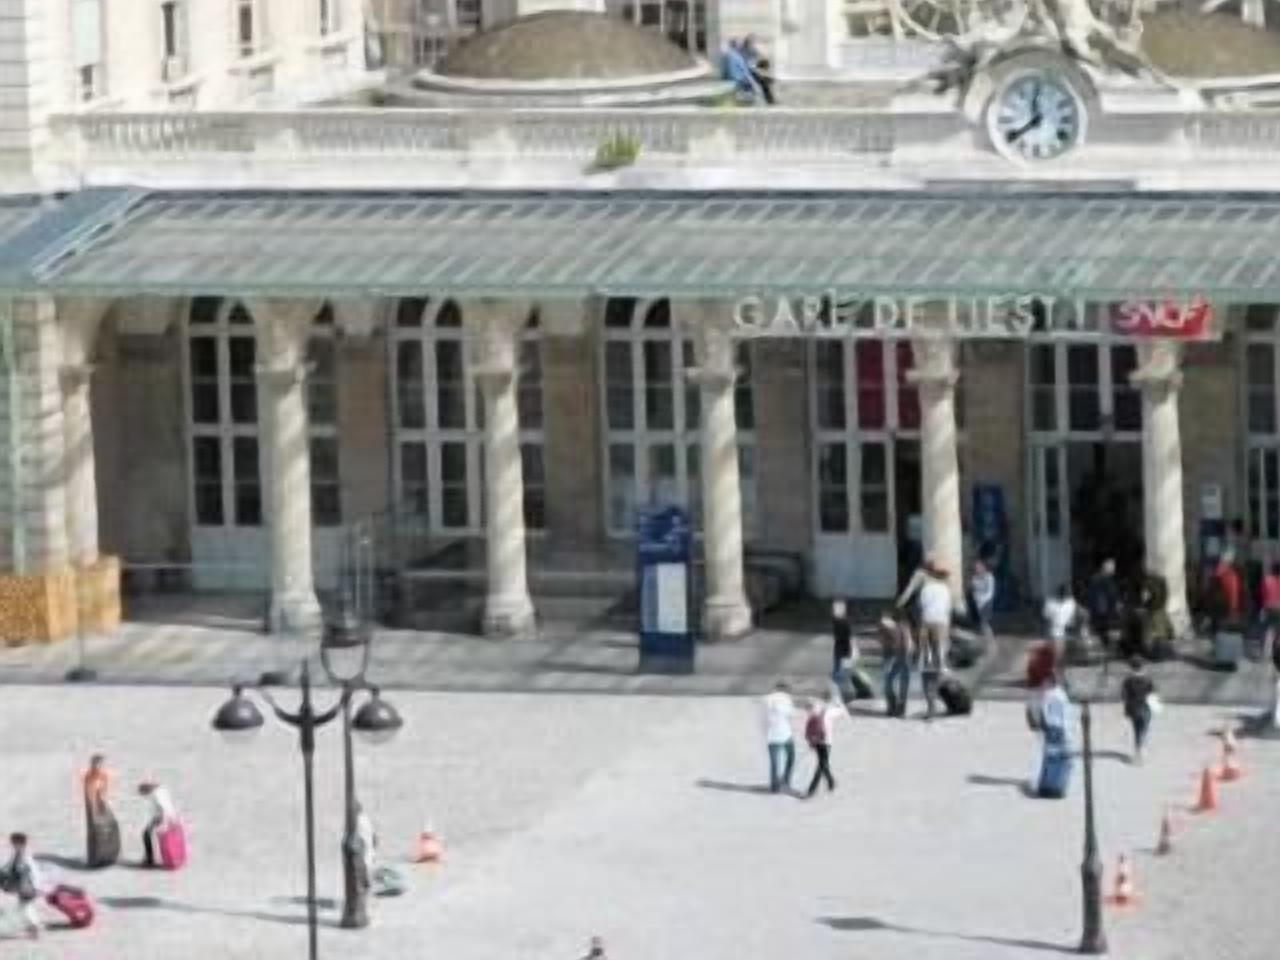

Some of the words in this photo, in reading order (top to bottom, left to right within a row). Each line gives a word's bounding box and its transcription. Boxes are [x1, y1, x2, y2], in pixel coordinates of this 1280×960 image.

[733, 294, 856, 331] GARE
[873, 294, 926, 331] DE
[1117, 296, 1209, 330] SNCF
